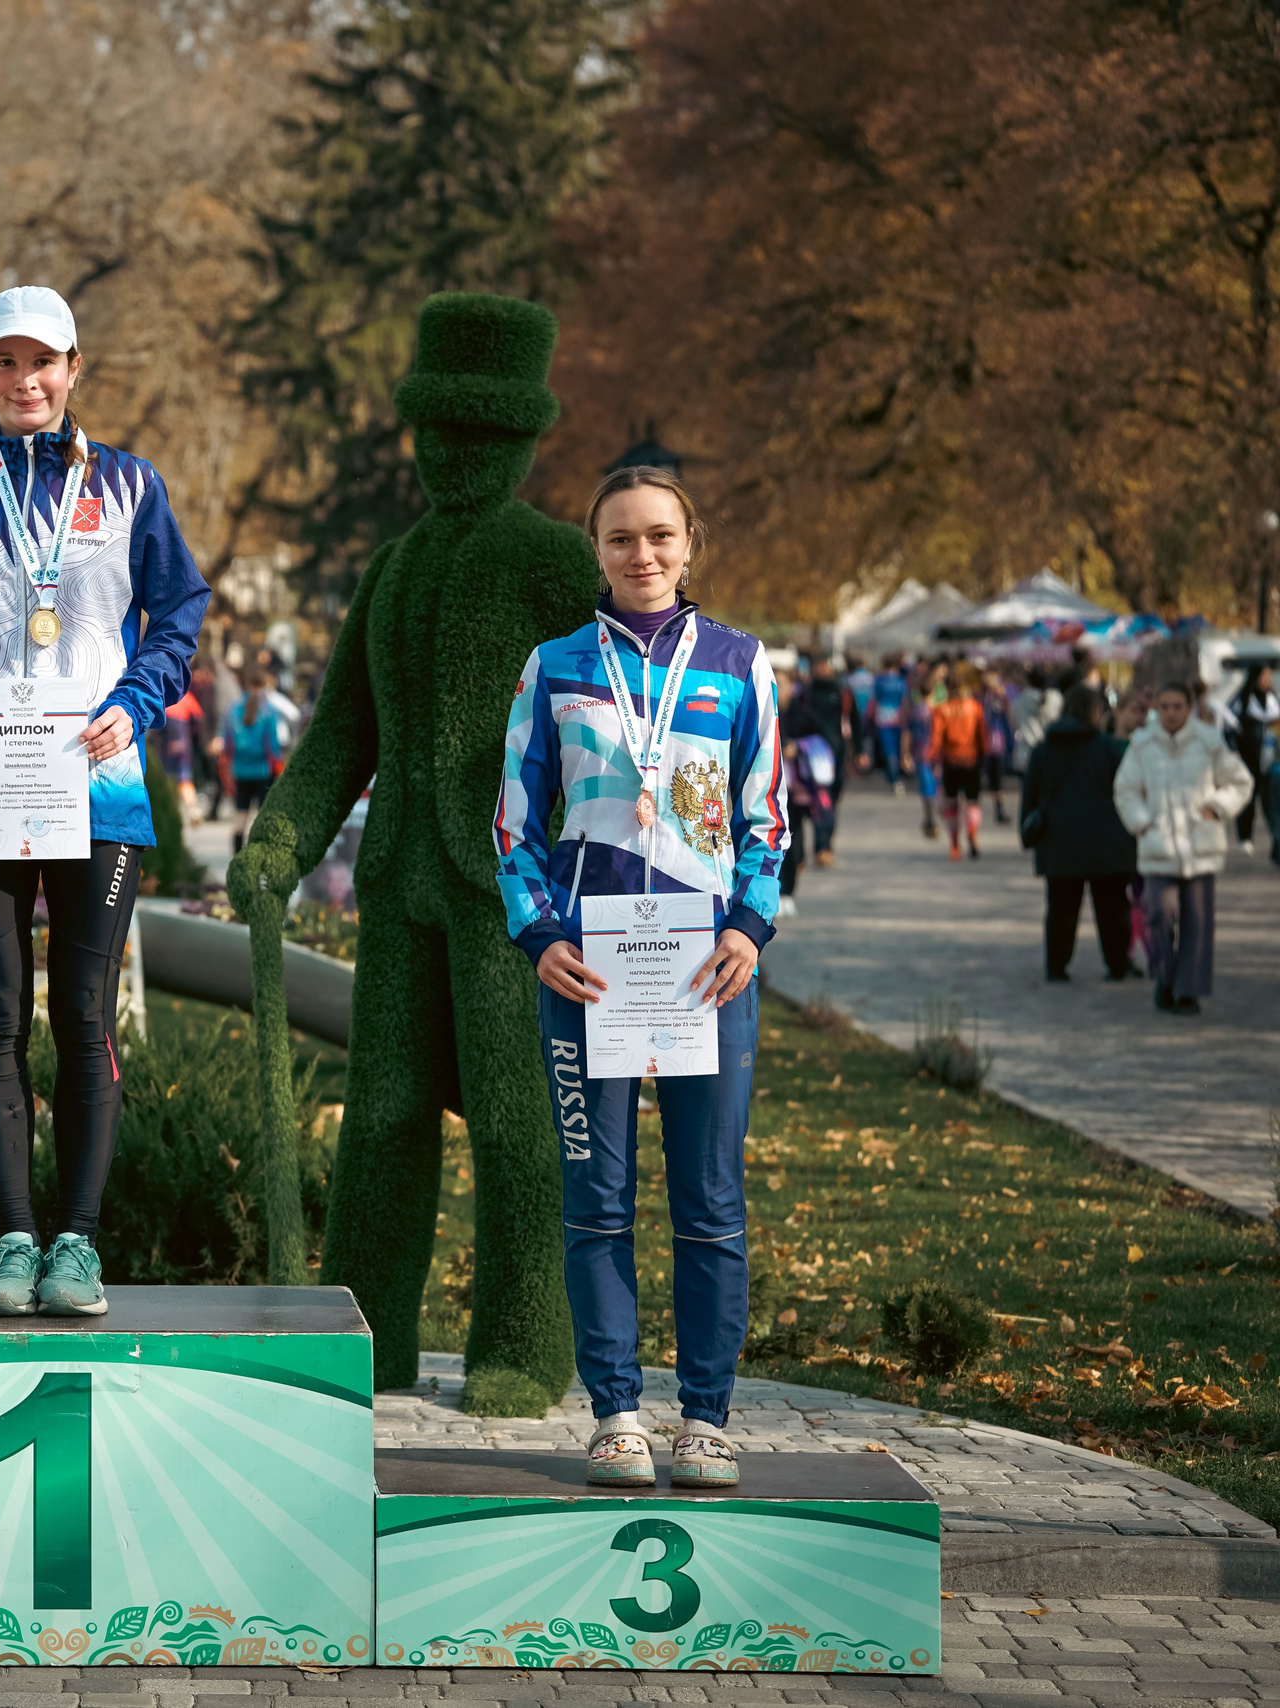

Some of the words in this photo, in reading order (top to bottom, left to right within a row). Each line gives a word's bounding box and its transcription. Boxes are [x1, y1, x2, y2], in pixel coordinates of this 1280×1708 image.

[0, 475, 18, 517] МИНИСТЕРСТВО
[13, 516, 25, 538] СПОРТА
[22, 538, 35, 564] РОССИИ
[52, 515, 68, 563] МИНИСТЕРСТВО
[64, 491, 74, 515] СПОРТА
[69, 465, 80, 490] РОССИИ
[560, 699, 616, 713] СЕВАСТОПОЛЬ
[606, 650, 622, 693] МИНИСТЕРСТВО
[618, 693, 628, 718] СПОРТА
[626, 718, 637, 745] РОССИИ
[656, 695, 672, 745] МИНИСТЕРСТВО
[669, 671, 679, 696] СПОРТА
[674, 649, 687, 670] РОССИИ
[616, 941, 680, 954] ДИПЛОМ
[550, 1037, 591, 1161] RUSSIA
[609, 1518, 700, 1634] 3
